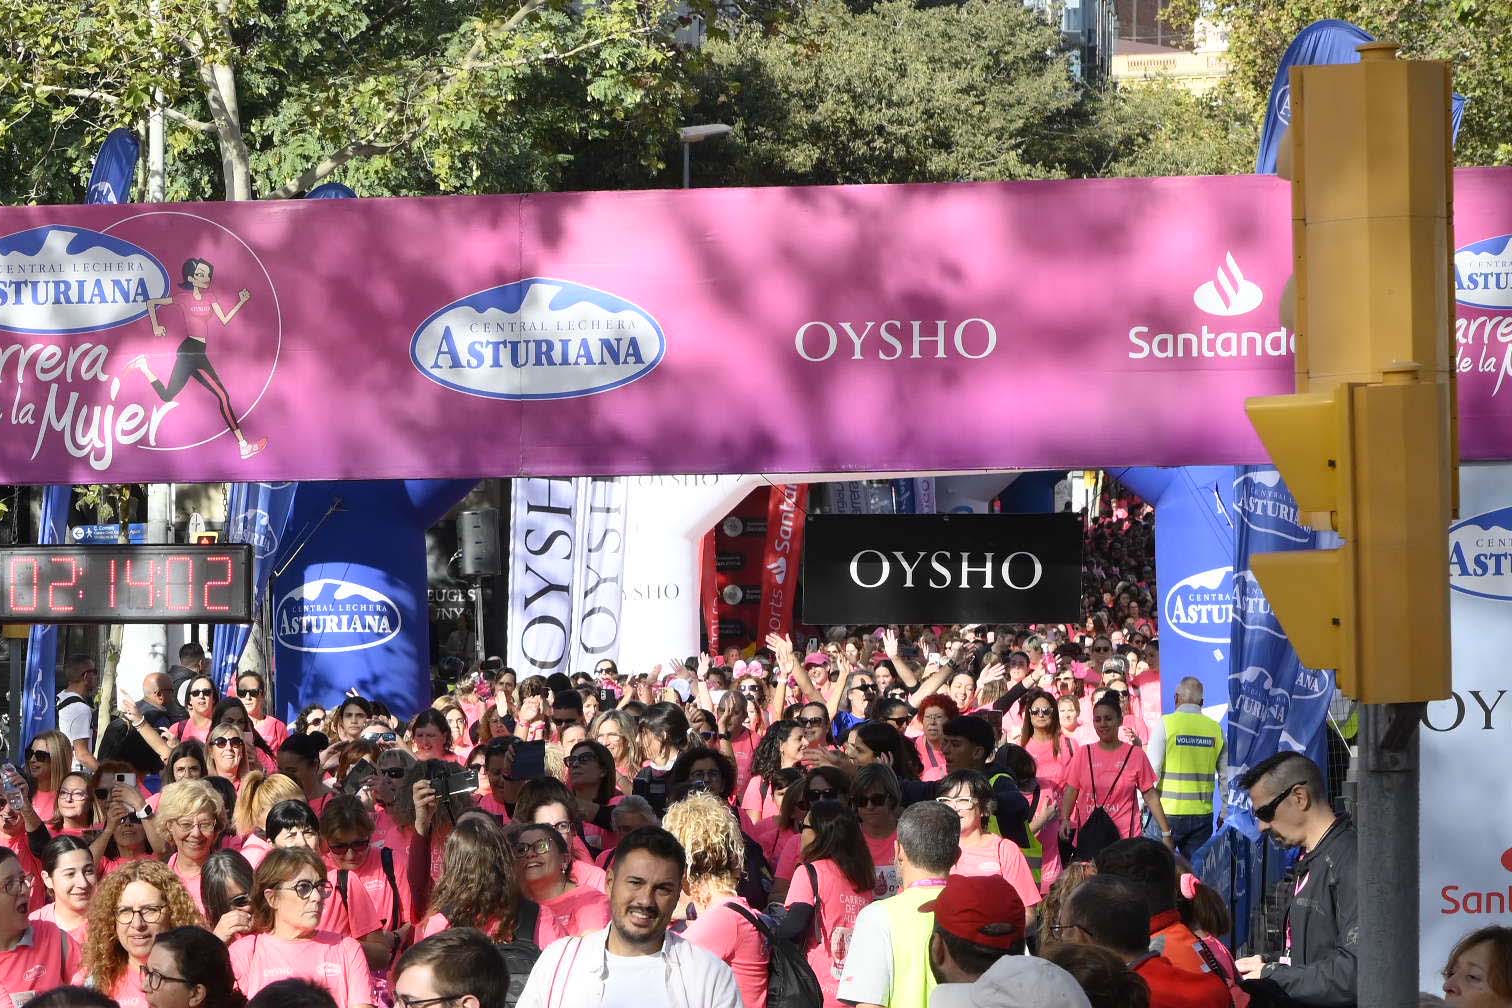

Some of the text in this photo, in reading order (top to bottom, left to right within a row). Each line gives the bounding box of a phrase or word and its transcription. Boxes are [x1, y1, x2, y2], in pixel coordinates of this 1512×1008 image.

[73, 261, 145, 273] LECHERA
[469, 318, 638, 333] CENTRAL LECHERA
[794, 317, 998, 361] OYSHO
[430, 325, 646, 369] ASTURIANA
[11, 384, 36, 425] la
[31, 376, 181, 472] Mujer
[9, 556, 233, 611] 02:14:02
[849, 549, 1042, 590] OYSHO
[279, 614, 392, 636] ASTURIANA
[338, 603, 388, 612] LECHERA
